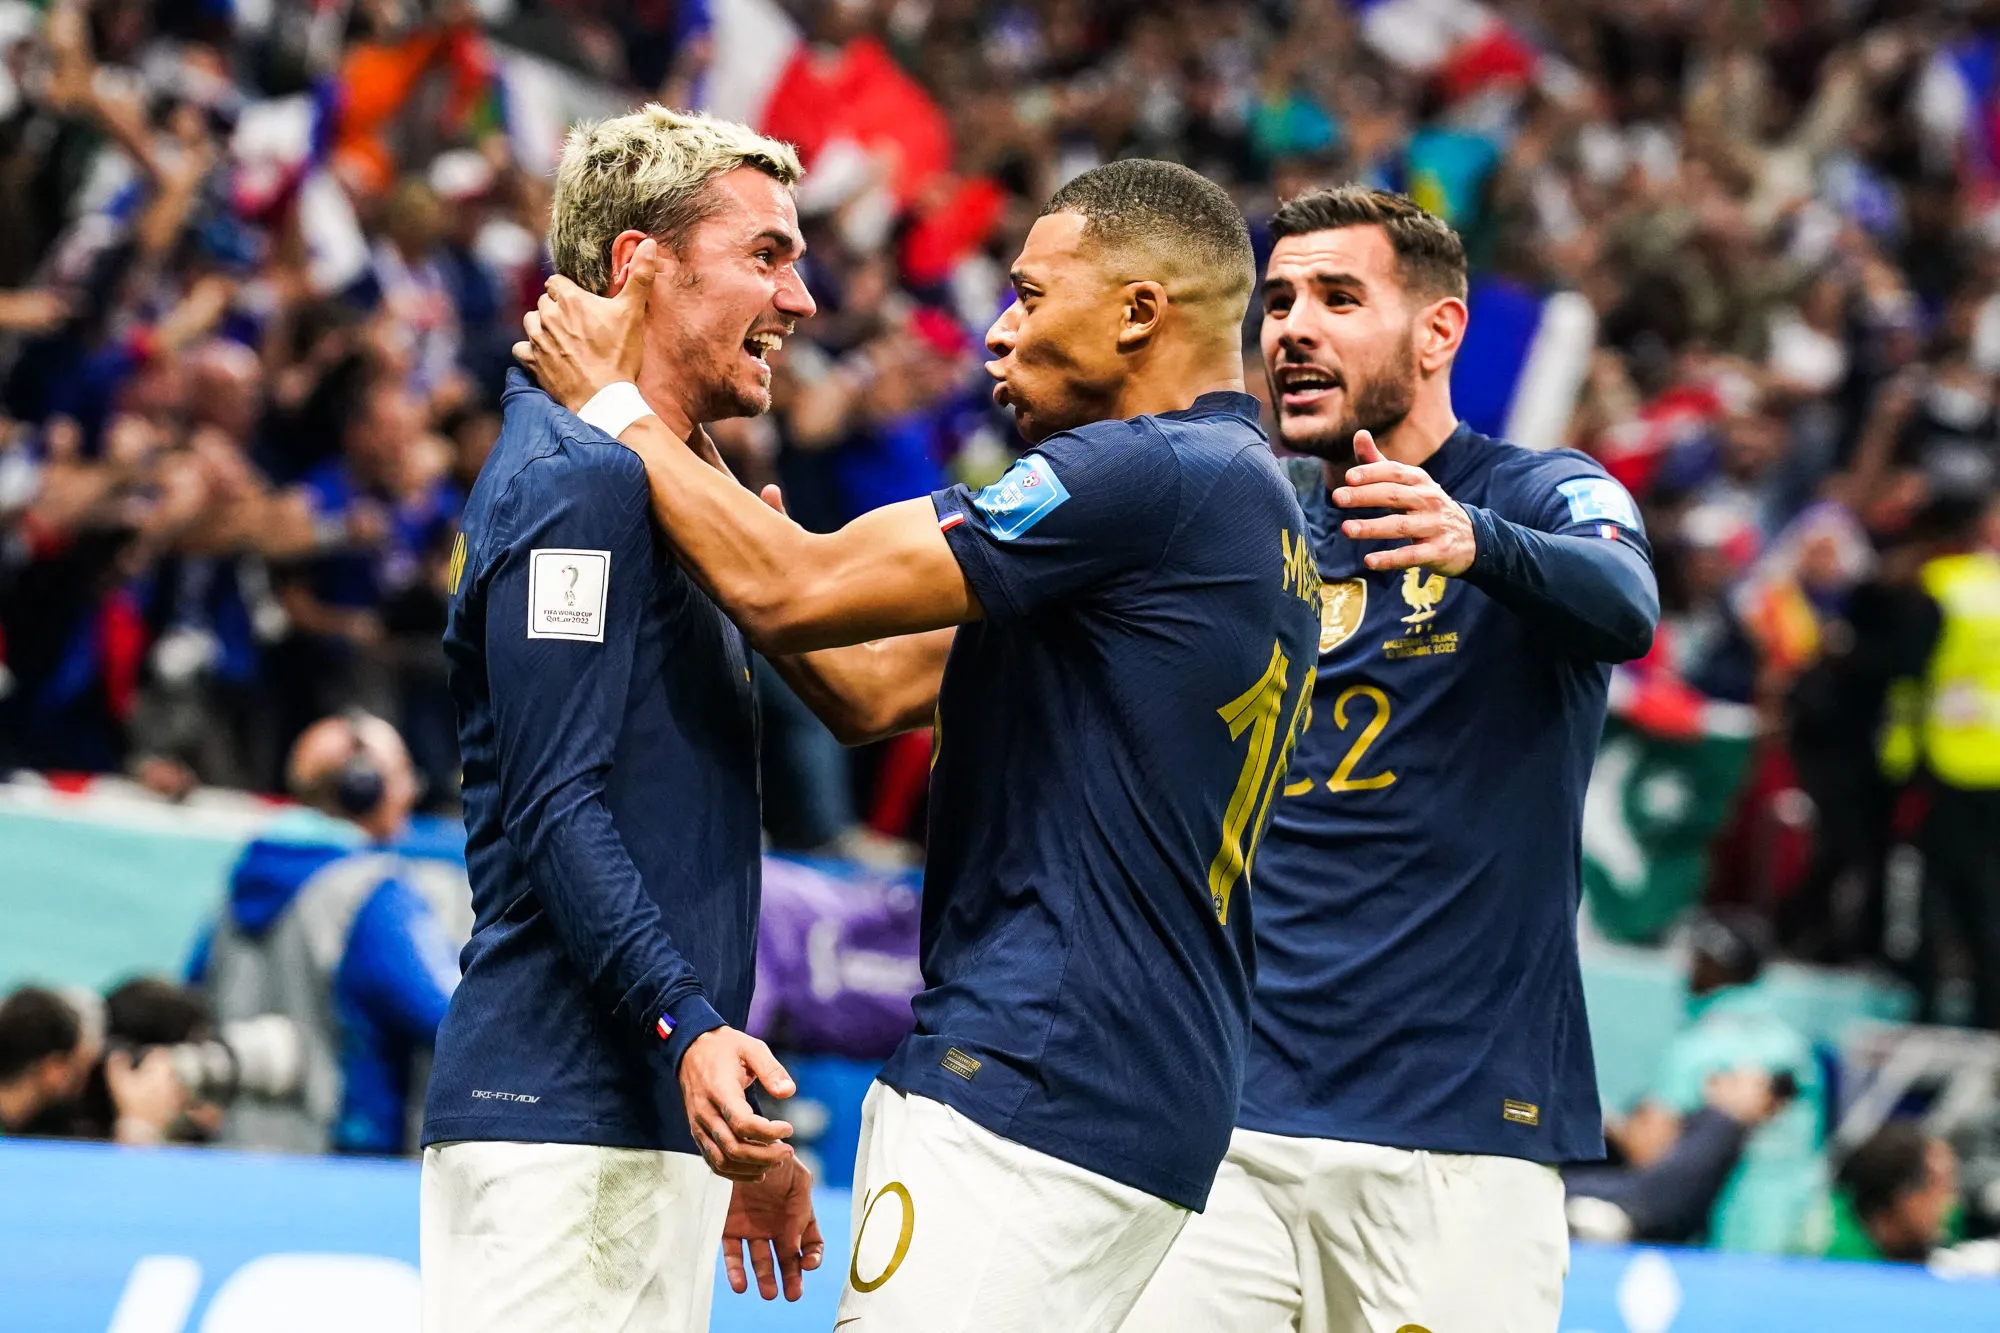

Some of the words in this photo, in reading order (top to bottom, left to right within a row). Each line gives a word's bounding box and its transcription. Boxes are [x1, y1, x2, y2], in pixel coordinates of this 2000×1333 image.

[1434, 642, 1457, 655] 2022
[1283, 684, 1397, 797] 2
[849, 1181, 915, 1294] 0
